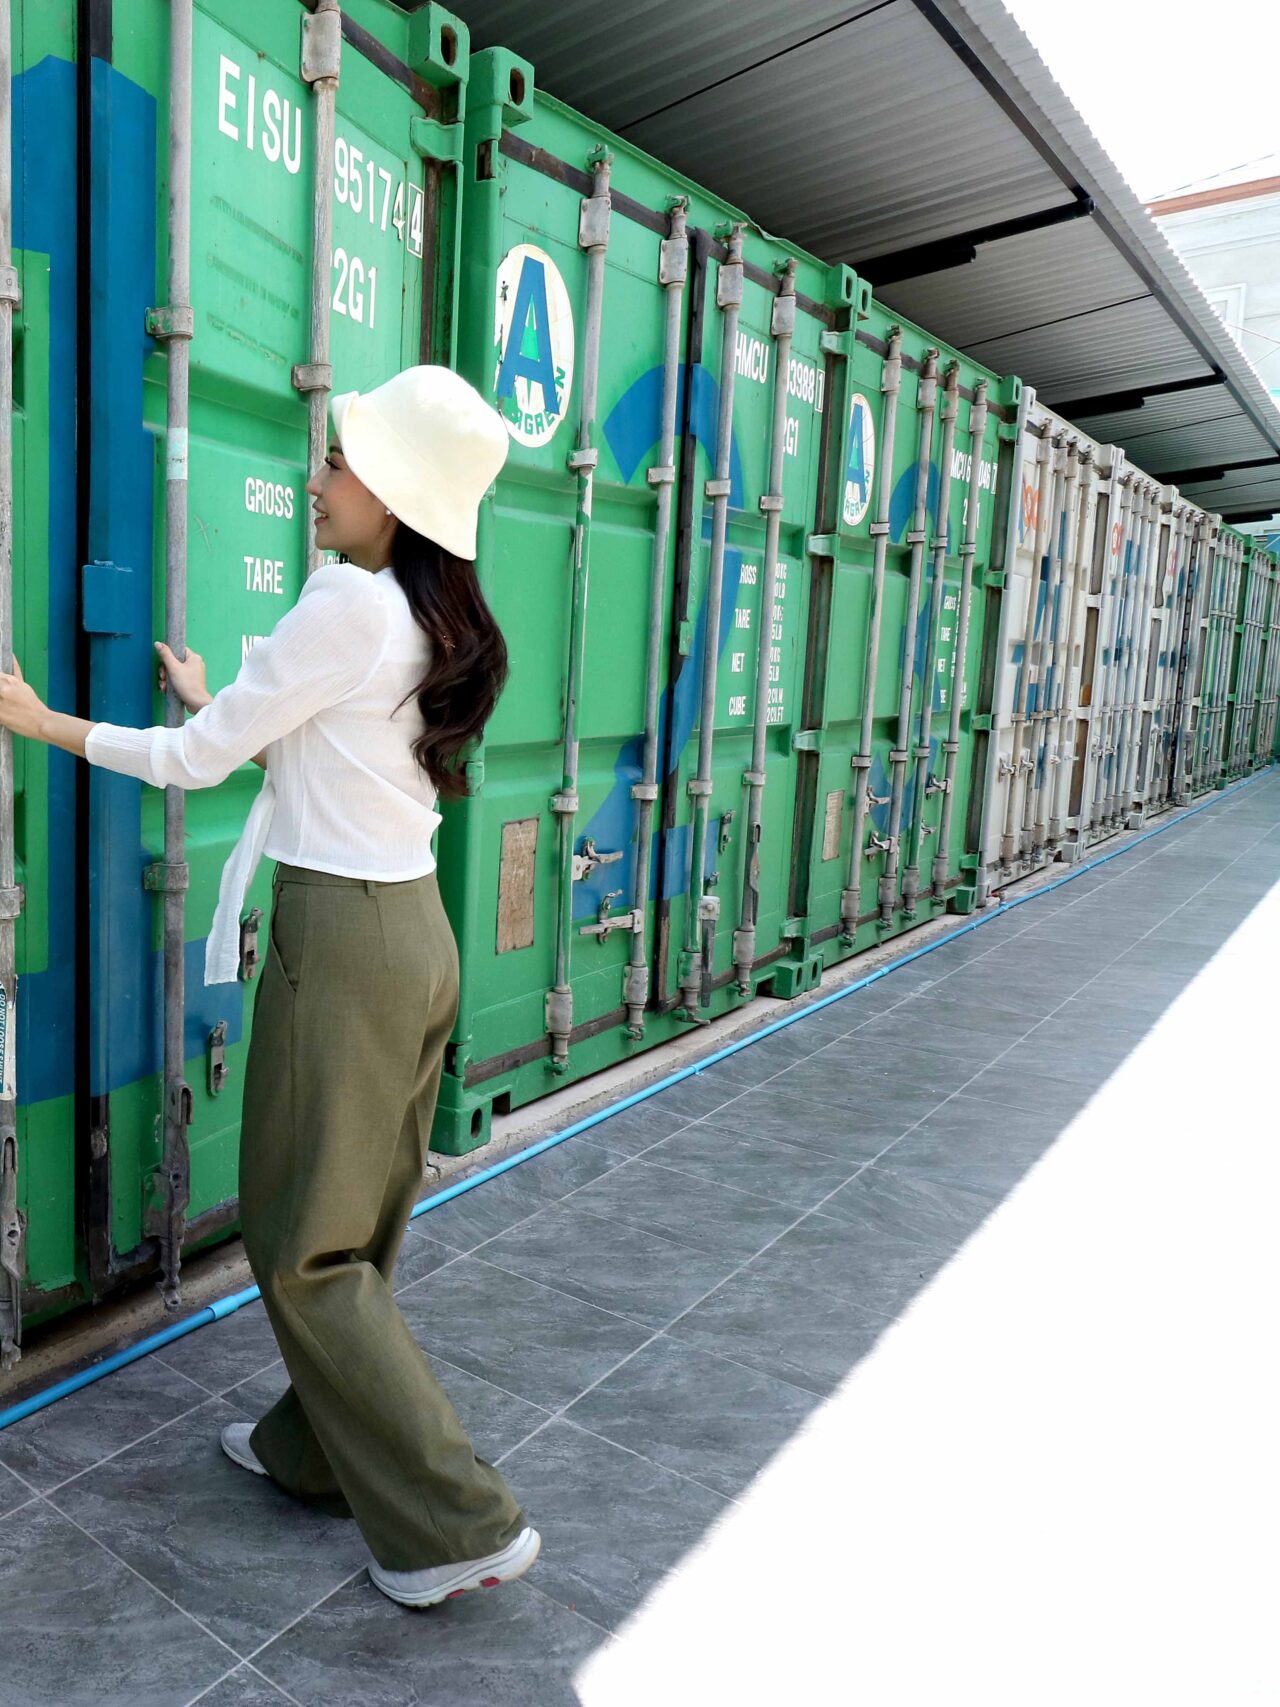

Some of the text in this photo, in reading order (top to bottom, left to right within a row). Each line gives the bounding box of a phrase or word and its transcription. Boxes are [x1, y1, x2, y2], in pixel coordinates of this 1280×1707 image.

[218, 53, 301, 174] EISU
[333, 137, 405, 241] 95174
[330, 247, 377, 328] 2G1
[734, 330, 769, 384] HMCU
[244, 477, 294, 520] GROSS
[243, 555, 284, 594] TARE
[739, 563, 757, 585] ROSS
[735, 608, 751, 628] TARE
[731, 652, 745, 673] NET
[728, 696, 747, 716] CUBE
